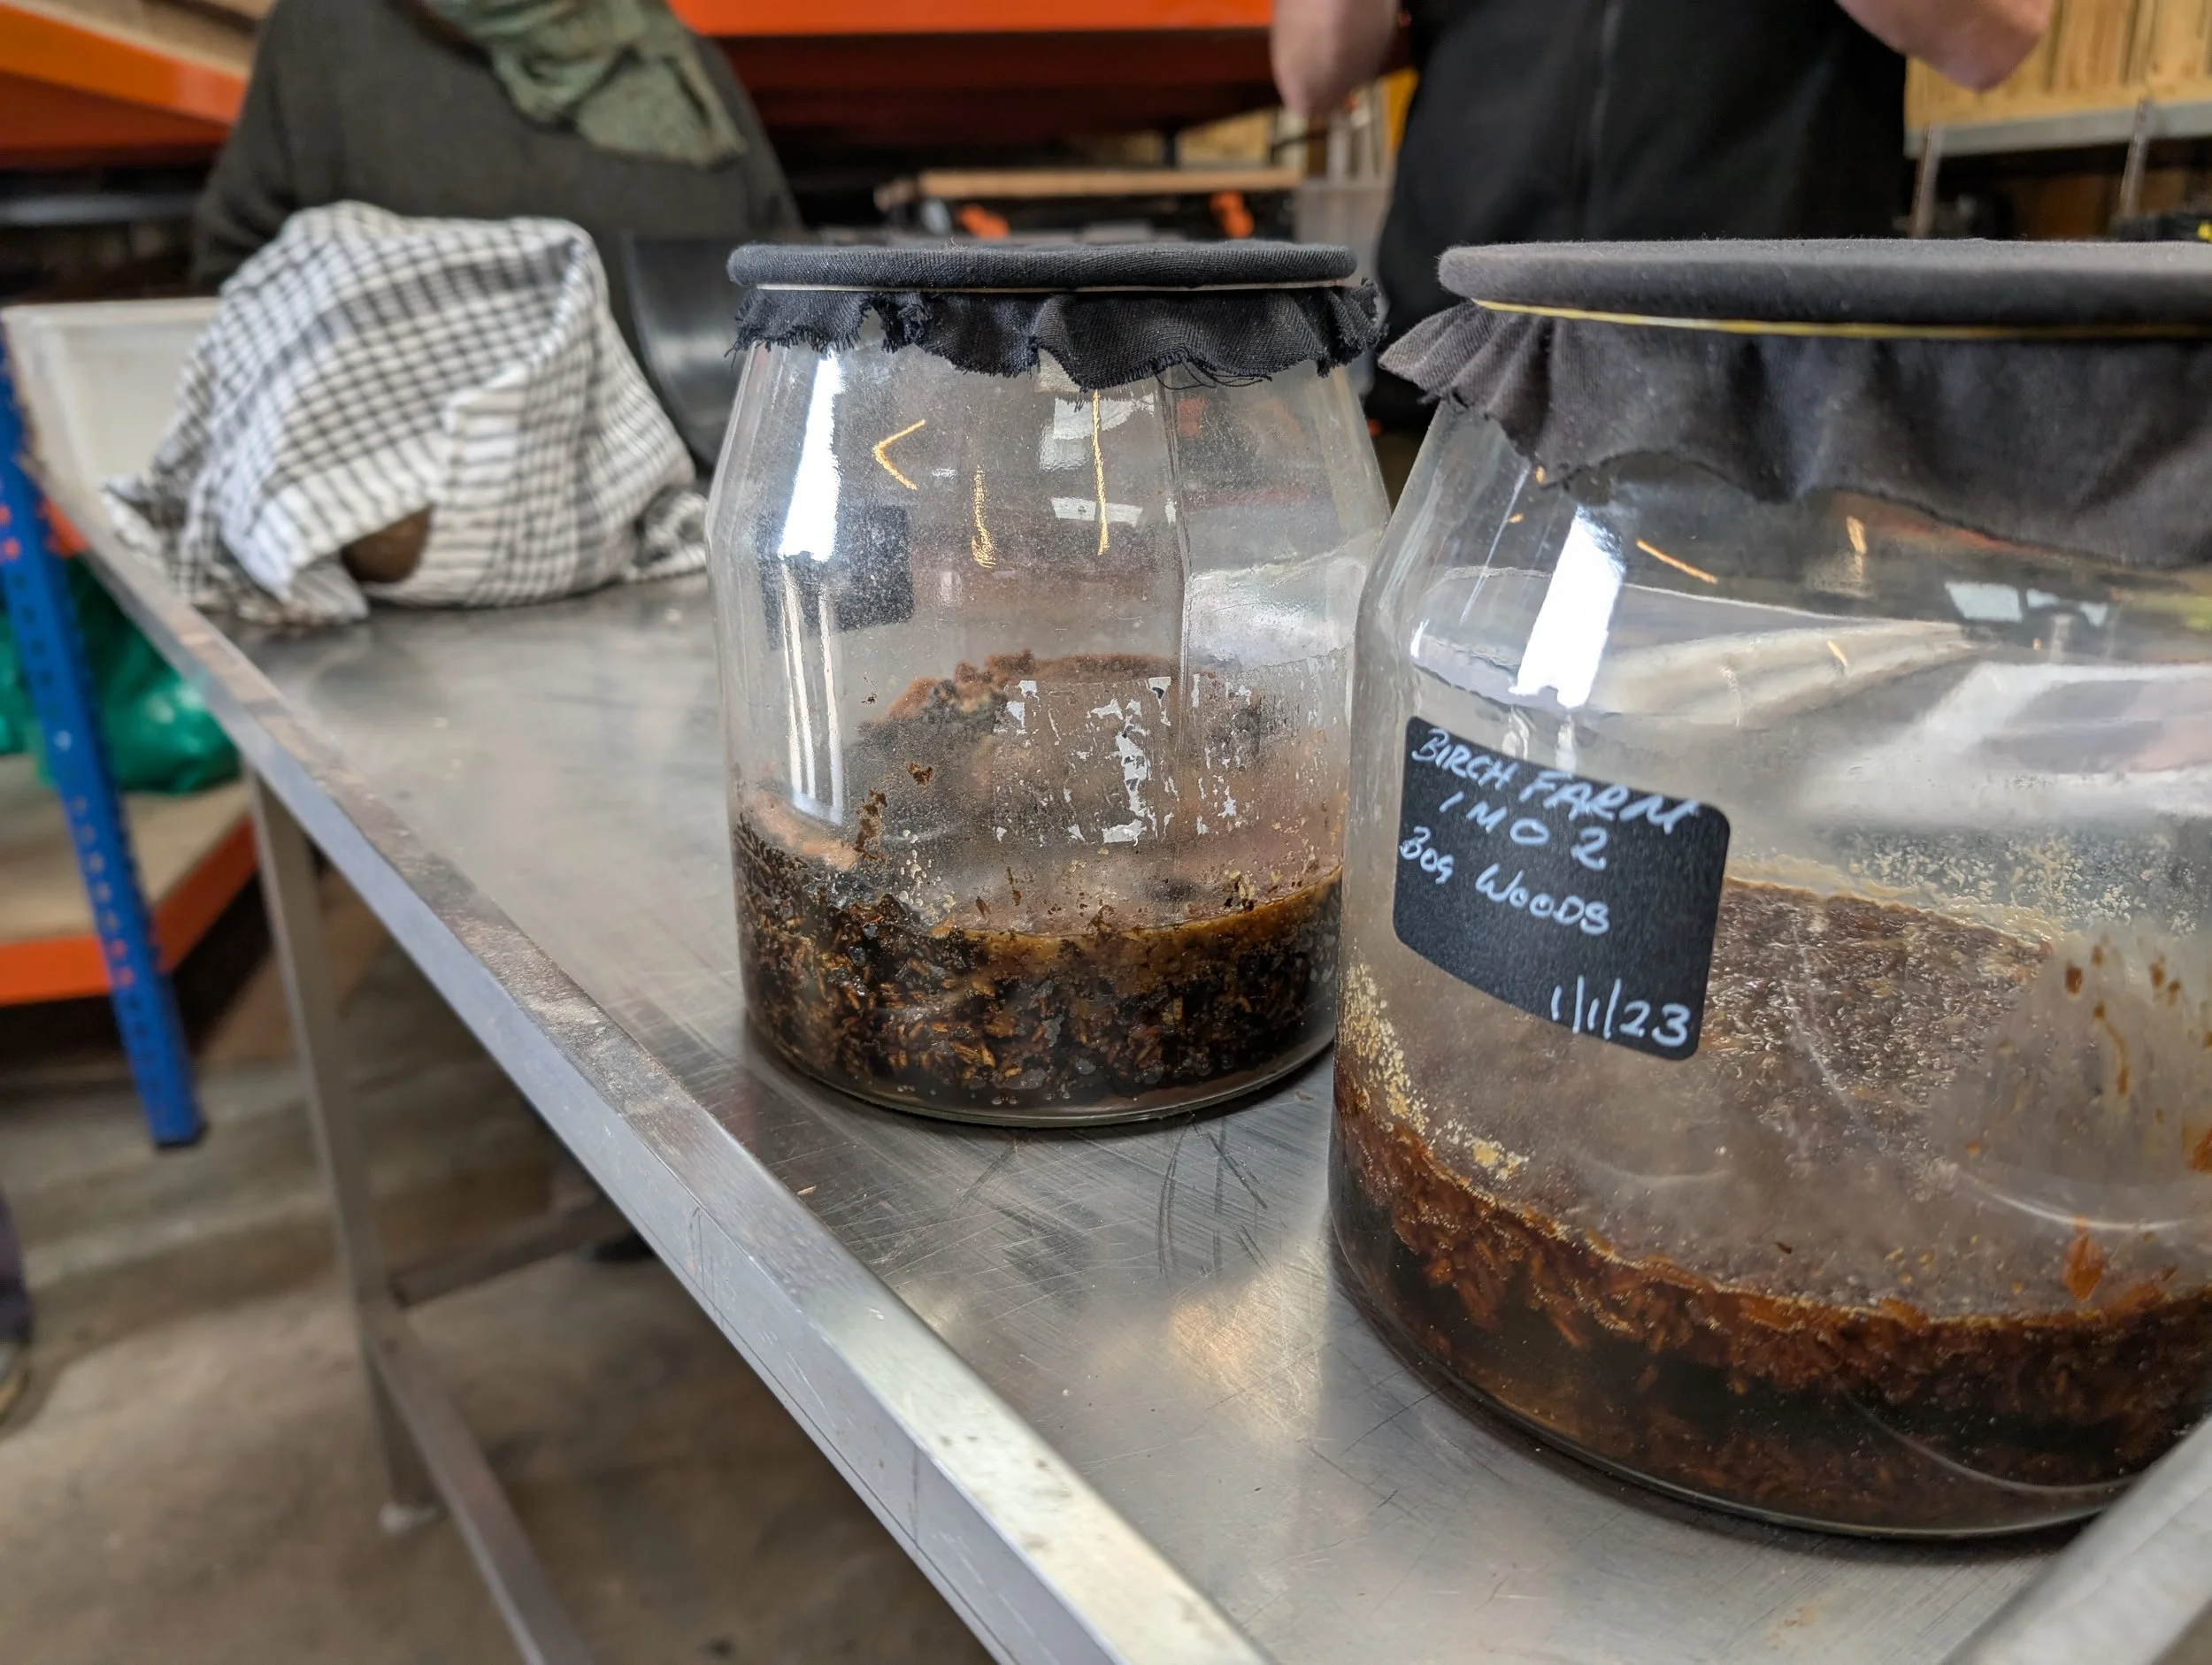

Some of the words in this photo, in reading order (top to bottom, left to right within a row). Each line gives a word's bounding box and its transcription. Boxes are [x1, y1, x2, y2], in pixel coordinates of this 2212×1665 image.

[1411, 728, 1519, 788] BIRCH
[1519, 771, 1701, 836] FARM
[1550, 974, 1692, 1047] 1/1/23
